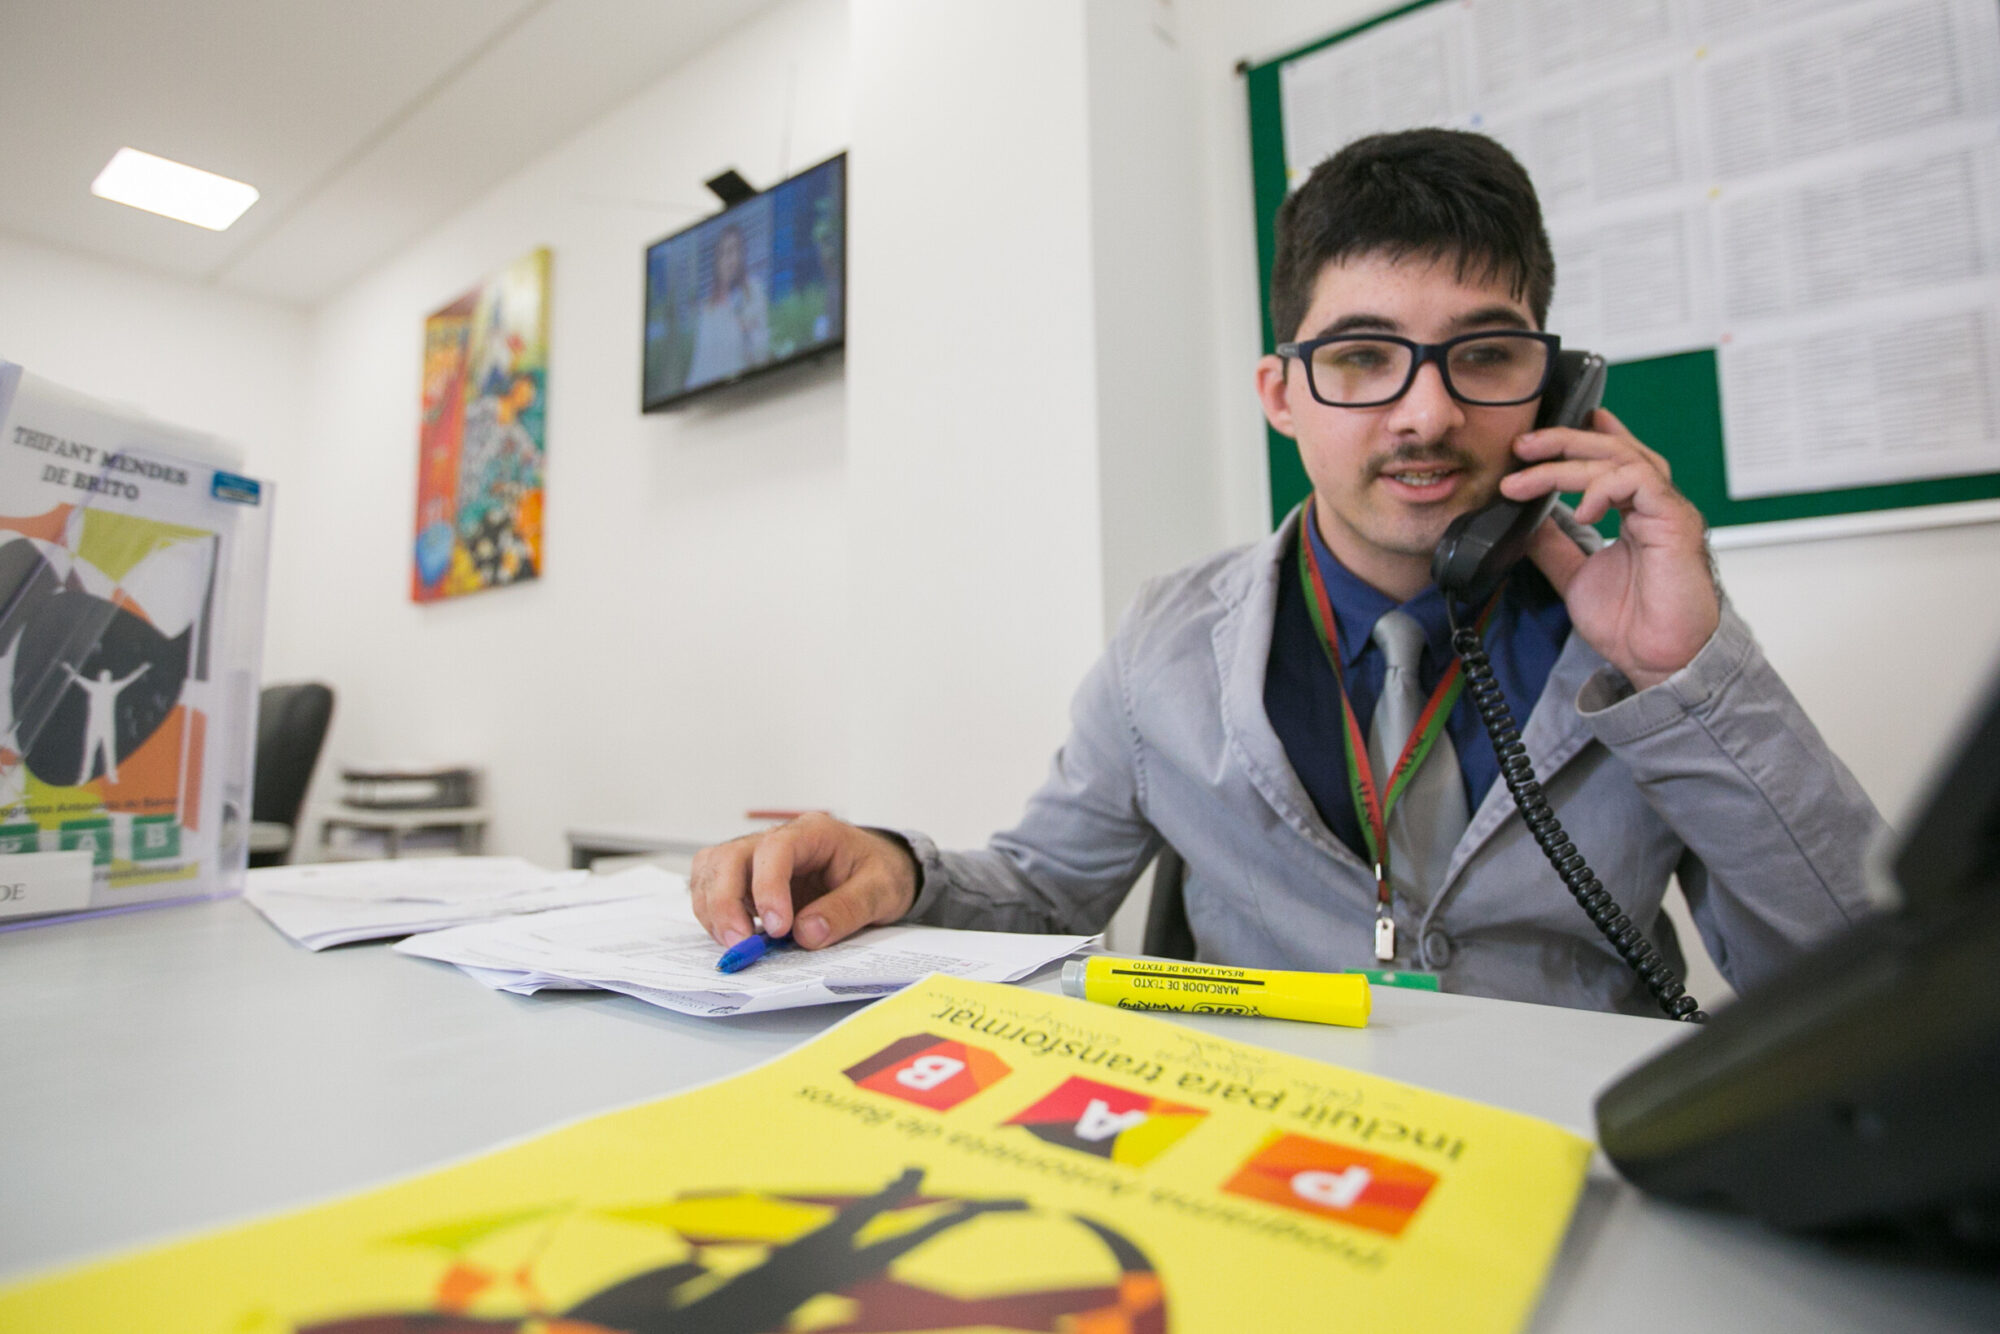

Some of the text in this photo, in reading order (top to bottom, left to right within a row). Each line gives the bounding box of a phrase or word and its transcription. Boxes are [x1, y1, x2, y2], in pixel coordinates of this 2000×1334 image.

[42, 464, 140, 501] DE BRITO
[101, 452, 188, 486] MENDES
[1132, 961, 1245, 977] RESALTADOR DE TEXTO
[1167, 980, 1180, 991] DE
[1182, 982, 1239, 995] MARCADOR
[930, 1003, 1165, 1084] transformar
[798, 1085, 894, 1126] Barros
[1176, 1070, 1287, 1113] para
[895, 1054, 1373, 1211] P A B
[1289, 1103, 1467, 1160] Incluir
